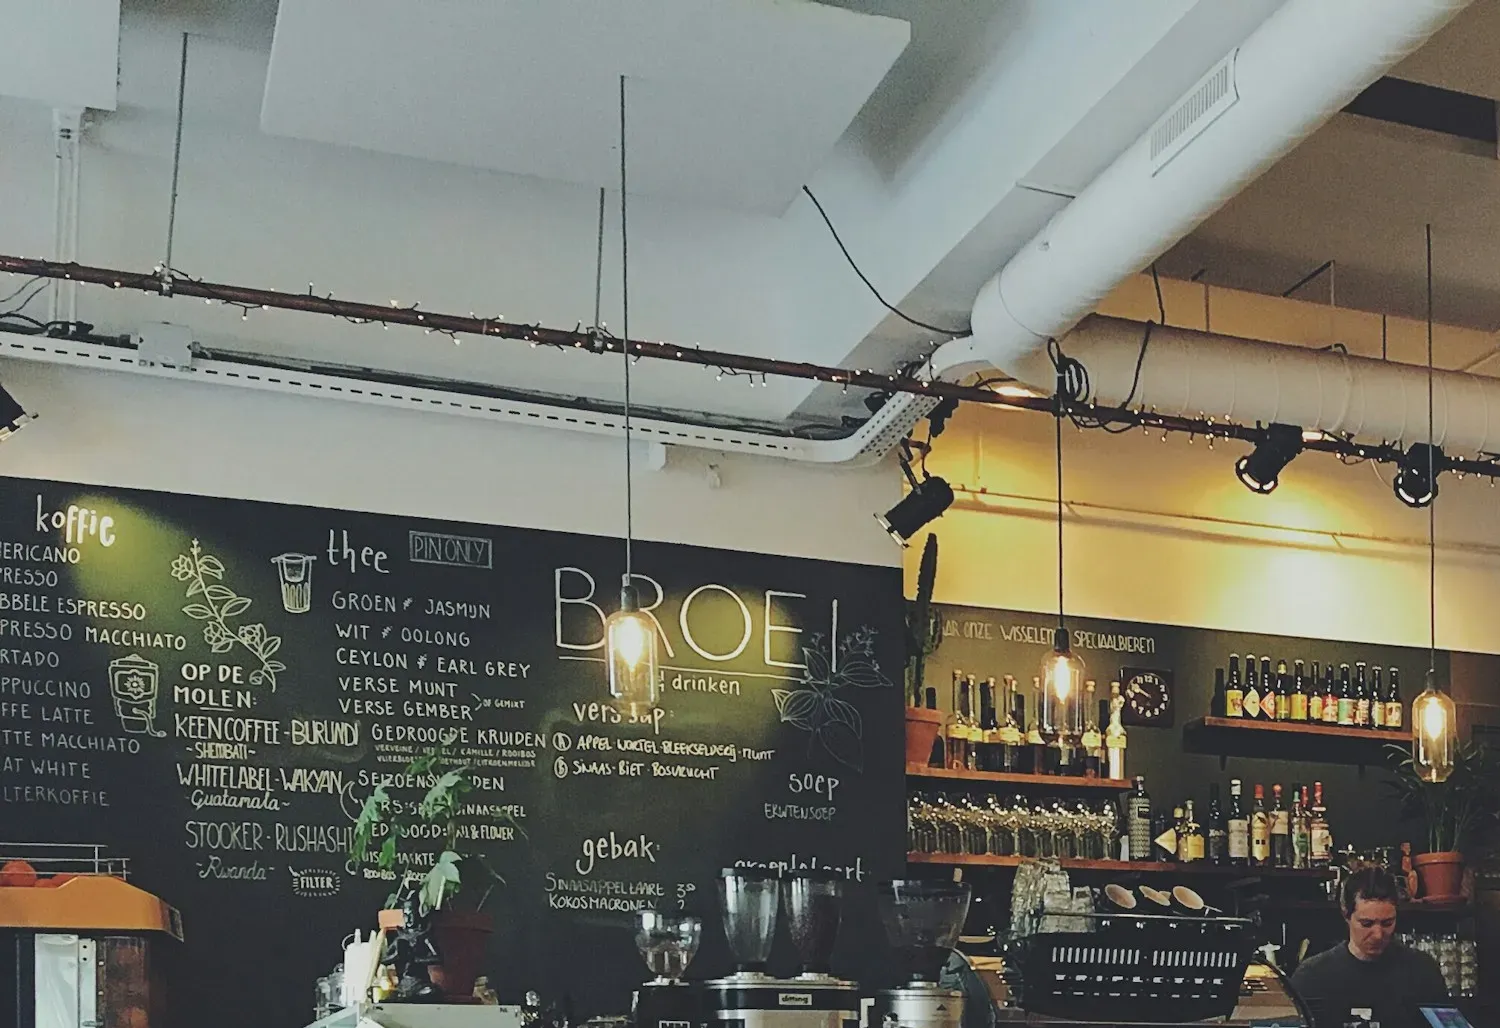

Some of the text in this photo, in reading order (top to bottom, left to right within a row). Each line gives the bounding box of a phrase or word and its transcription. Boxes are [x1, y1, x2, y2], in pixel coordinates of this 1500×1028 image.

[36, 494, 116, 547] koffie
[0, 542, 81, 564] ERICANO
[327, 529, 390, 573] thee
[58, 598, 146, 621] ESPRESSO
[332, 590, 396, 613] GROEN
[424, 598, 491, 619] JASMIJN
[85, 626, 187, 650] MACCHIATO
[335, 623, 370, 641] WIT
[401, 626, 470, 648] OOLONG
[181, 663, 245, 684] OP DE
[336, 648, 408, 670] CEYLON
[437, 656, 477, 676] EARL
[485, 661, 531, 679] GREY
[1, 677, 91, 699] PPUCCINO
[339, 676, 458, 698] VERSE MUNT
[671, 674, 740, 696] drinken
[174, 685, 258, 709] MOLEN:
[2, 703, 95, 725] FFE LATTE
[338, 698, 395, 716] VERSE
[403, 700, 473, 722] GEMBER
[2, 730, 141, 753] TTE MACCHIATO
[477, 729, 546, 748] KRUIDEN
[3, 756, 91, 779] AT WHITE
[3, 786, 111, 807] LTERKOFFIE
[788, 773, 840, 801] soep
[184, 820, 264, 851] STOOKER
[575, 831, 661, 875] gebak:
[300, 876, 334, 890] FILTER
